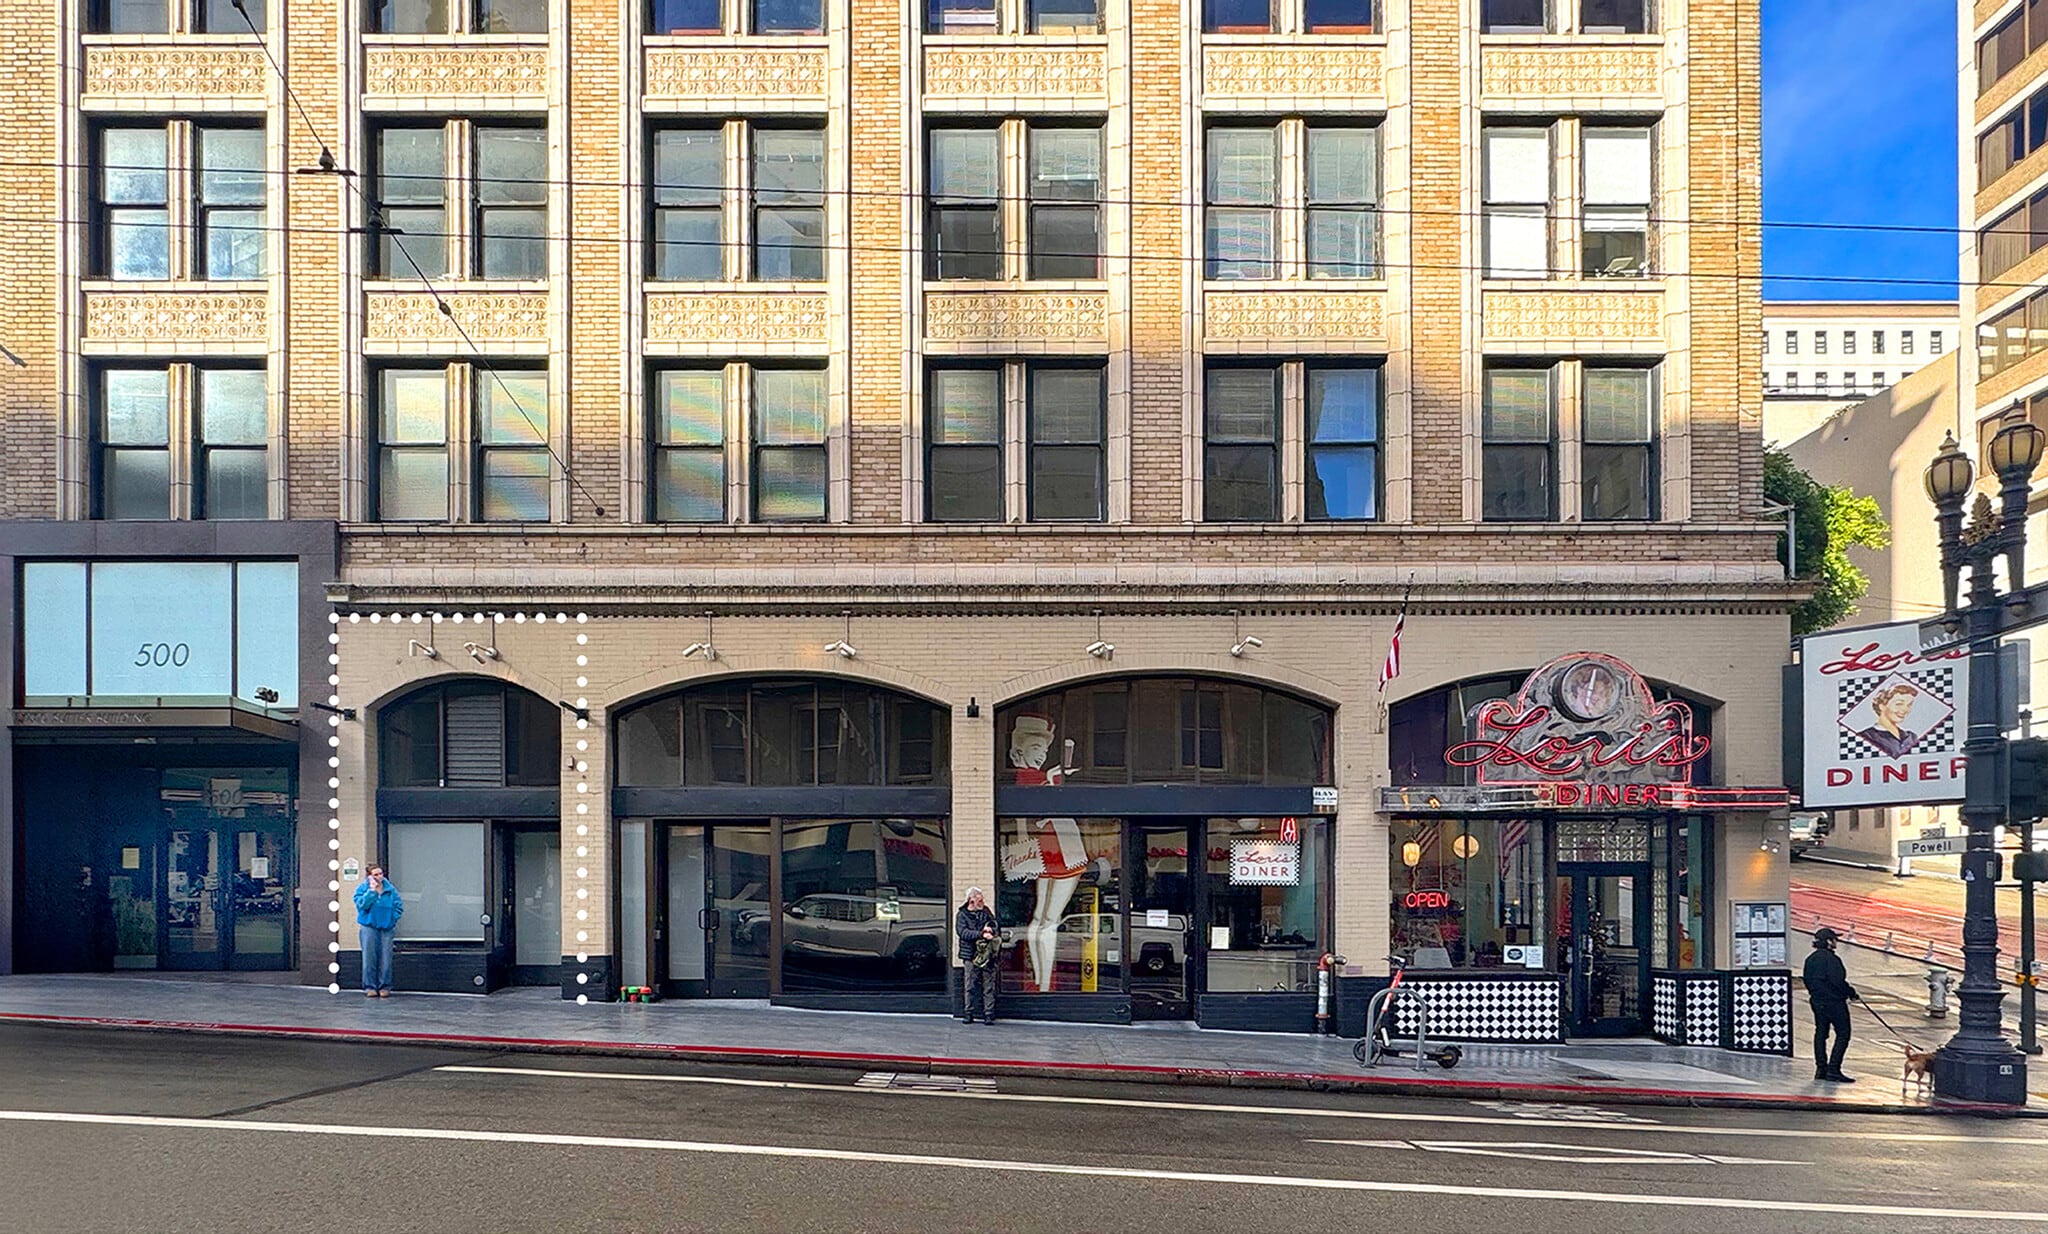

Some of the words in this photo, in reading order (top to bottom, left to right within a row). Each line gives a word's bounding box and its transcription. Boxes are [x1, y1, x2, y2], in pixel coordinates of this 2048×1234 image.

[134, 643, 190, 667] 500
[1820, 642, 1973, 674] Lors
[1444, 707, 1710, 774] Lori's
[1556, 784, 1661, 805] DINER
[1911, 841, 1952, 853] Powell
[1237, 850, 1294, 864] Lori's
[1240, 866, 1289, 876] DINER
[1405, 892, 1448, 908] OPEN
